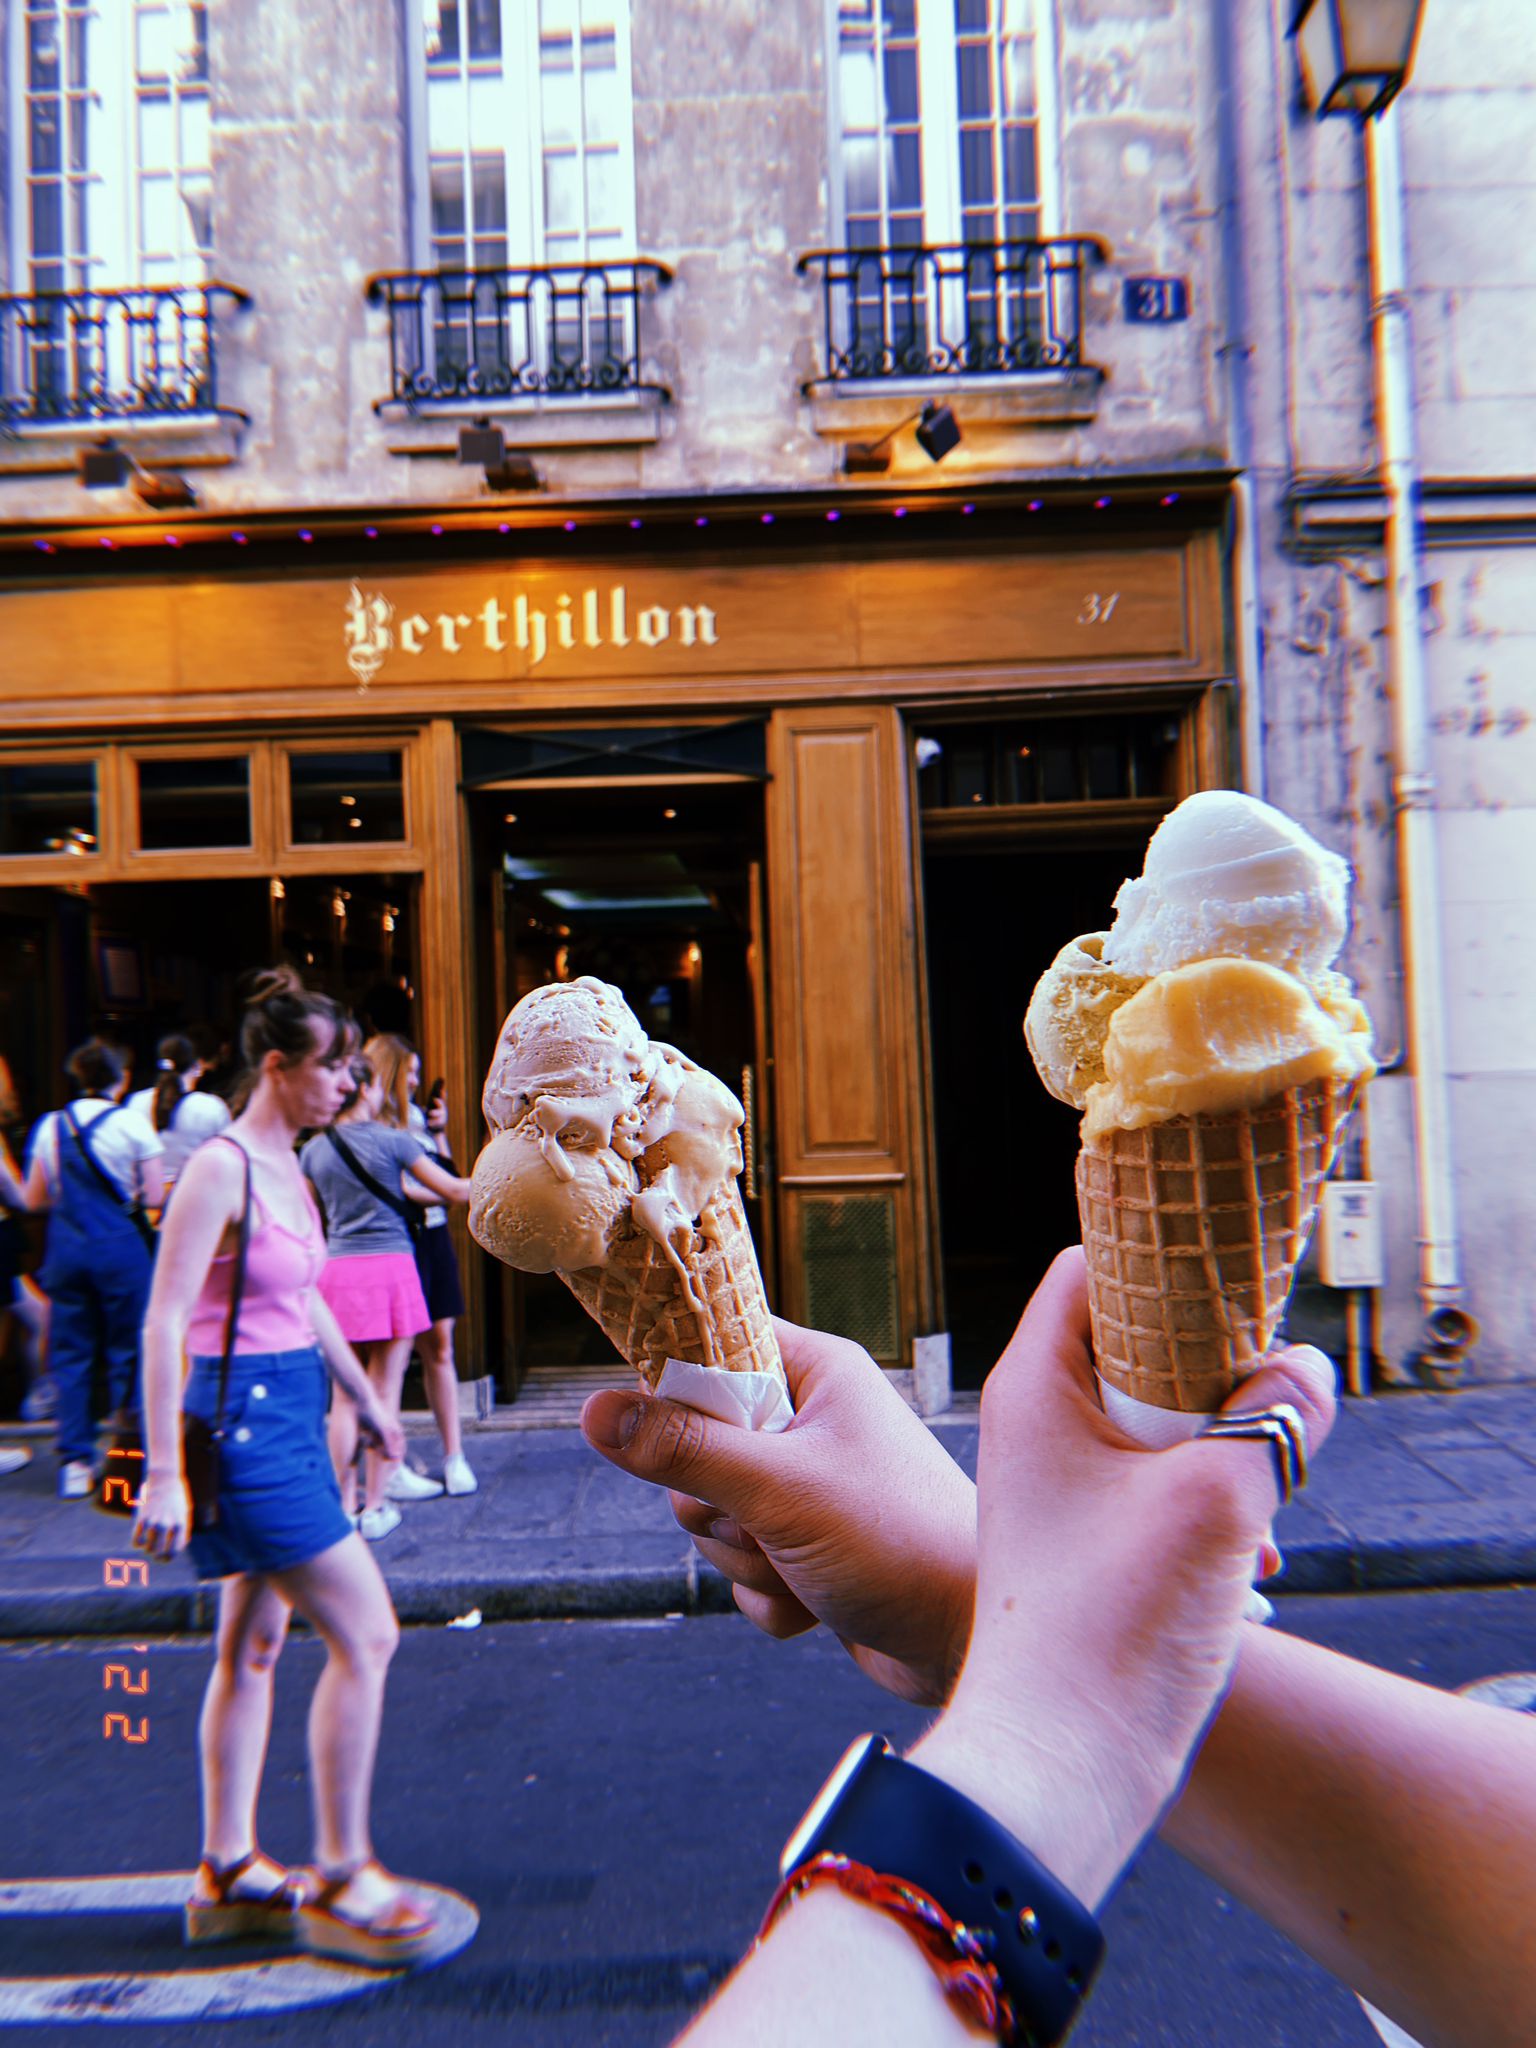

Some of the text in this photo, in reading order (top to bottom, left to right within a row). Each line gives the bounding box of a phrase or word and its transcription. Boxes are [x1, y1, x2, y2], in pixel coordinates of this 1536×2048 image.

[1139, 282, 1173, 318] 31
[1075, 592, 1120, 624] 31
[344, 577, 719, 695] Berthillon
